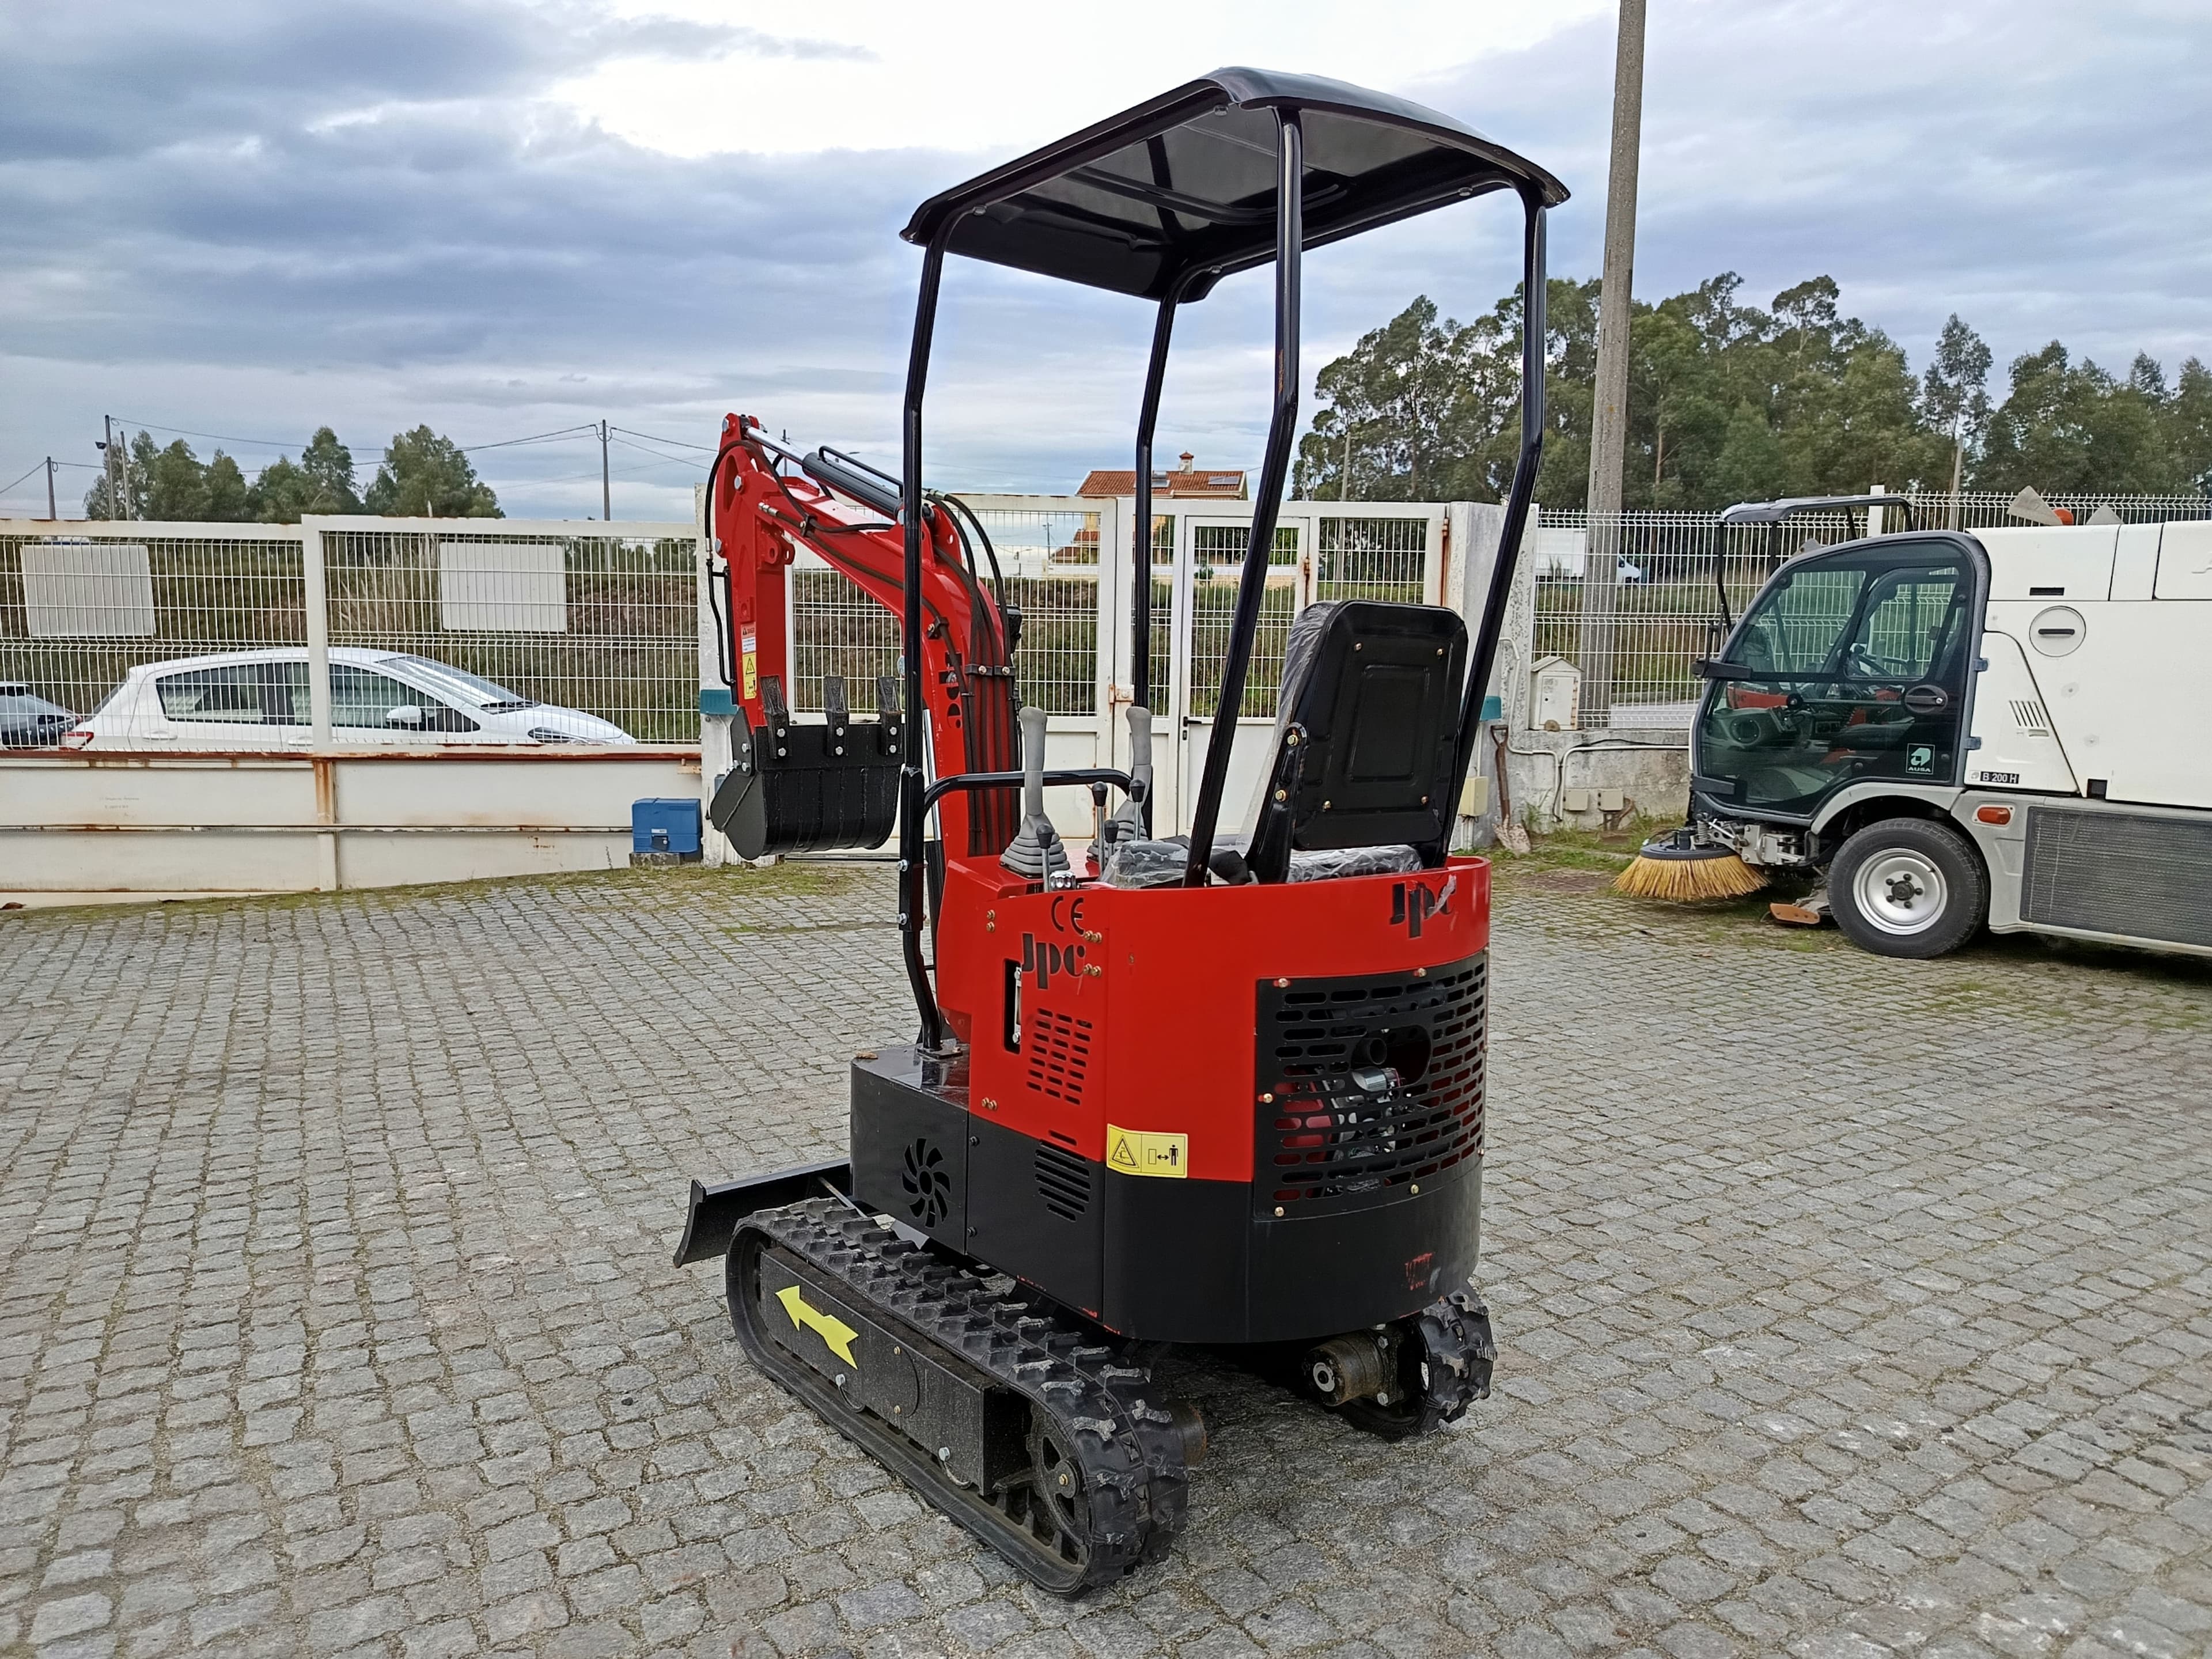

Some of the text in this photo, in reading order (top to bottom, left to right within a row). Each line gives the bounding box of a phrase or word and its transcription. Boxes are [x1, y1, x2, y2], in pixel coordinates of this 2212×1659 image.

[1983, 772, 2017, 783] B 200 H
[1051, 895, 1085, 935] CE
